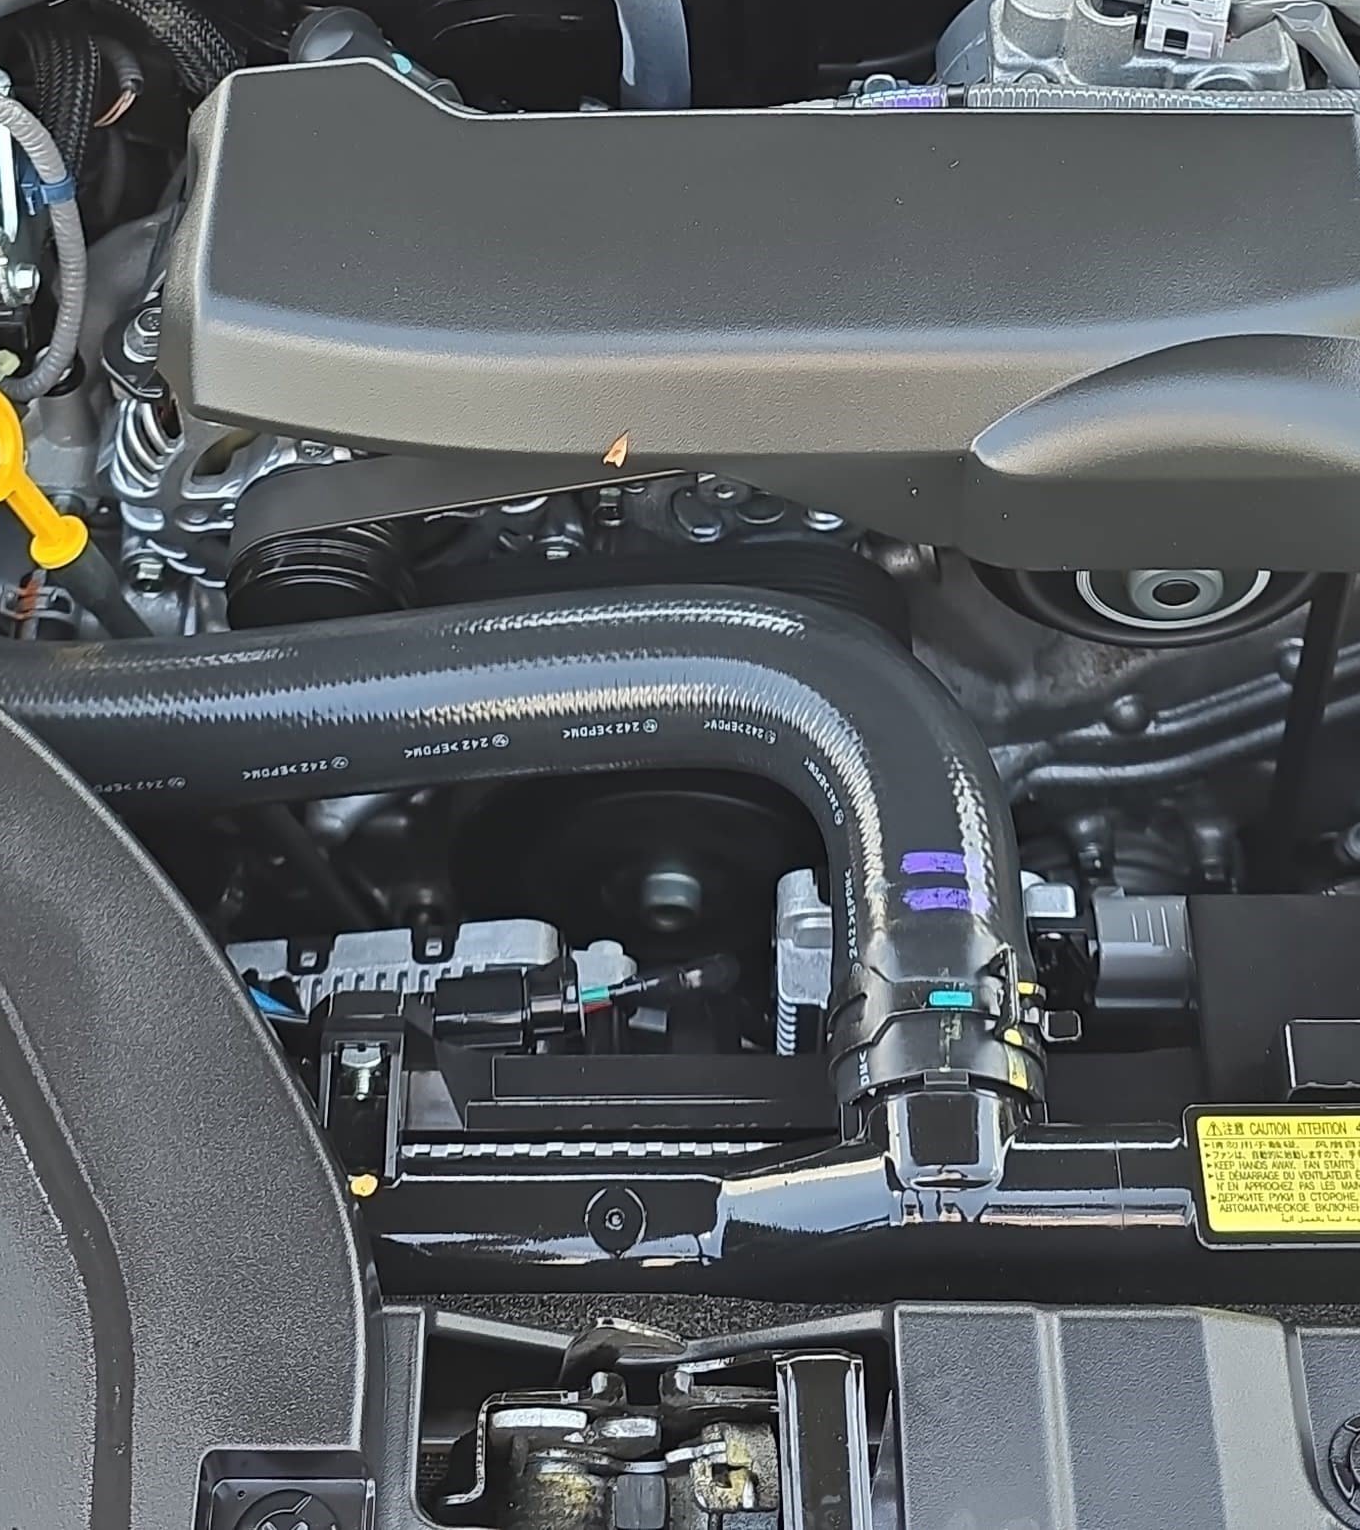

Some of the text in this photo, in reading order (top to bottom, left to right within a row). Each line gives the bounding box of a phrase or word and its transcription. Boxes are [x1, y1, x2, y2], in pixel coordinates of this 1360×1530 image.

[1250, 1122, 1291, 1135] CAUTION
[1297, 1122, 1347, 1135] ATTENTION
[1214, 1161, 1235, 1170] KEEP
[1240, 1161, 1268, 1170] HANDS
[1272, 1161, 1296, 1170] AWAY.
[1304, 1161, 1320, 1170] FAN
[1324, 1160, 1355, 1169] STARTS
[1216, 1172, 1225, 1181] LE
[1229, 1170, 1280, 1180] DÉMARRAGE
[1283, 1171, 1295, 1180] DU
[1300, 1171, 1353, 1180] VENTILATEUR
[1244, 1182, 1294, 1191] APPROCHEZ
[1300, 1181, 1315, 1191] PAS
[1321, 1181, 1336, 1190] LES
[1218, 1193, 1264, 1203] ДЕРЖИТЕ
[1269, 1192, 1294, 1201] РУКИ
[1299, 1192, 1306, 1201] В
[1220, 1203, 1311, 1212] АВТОМАТИЧЕСКОЕ
